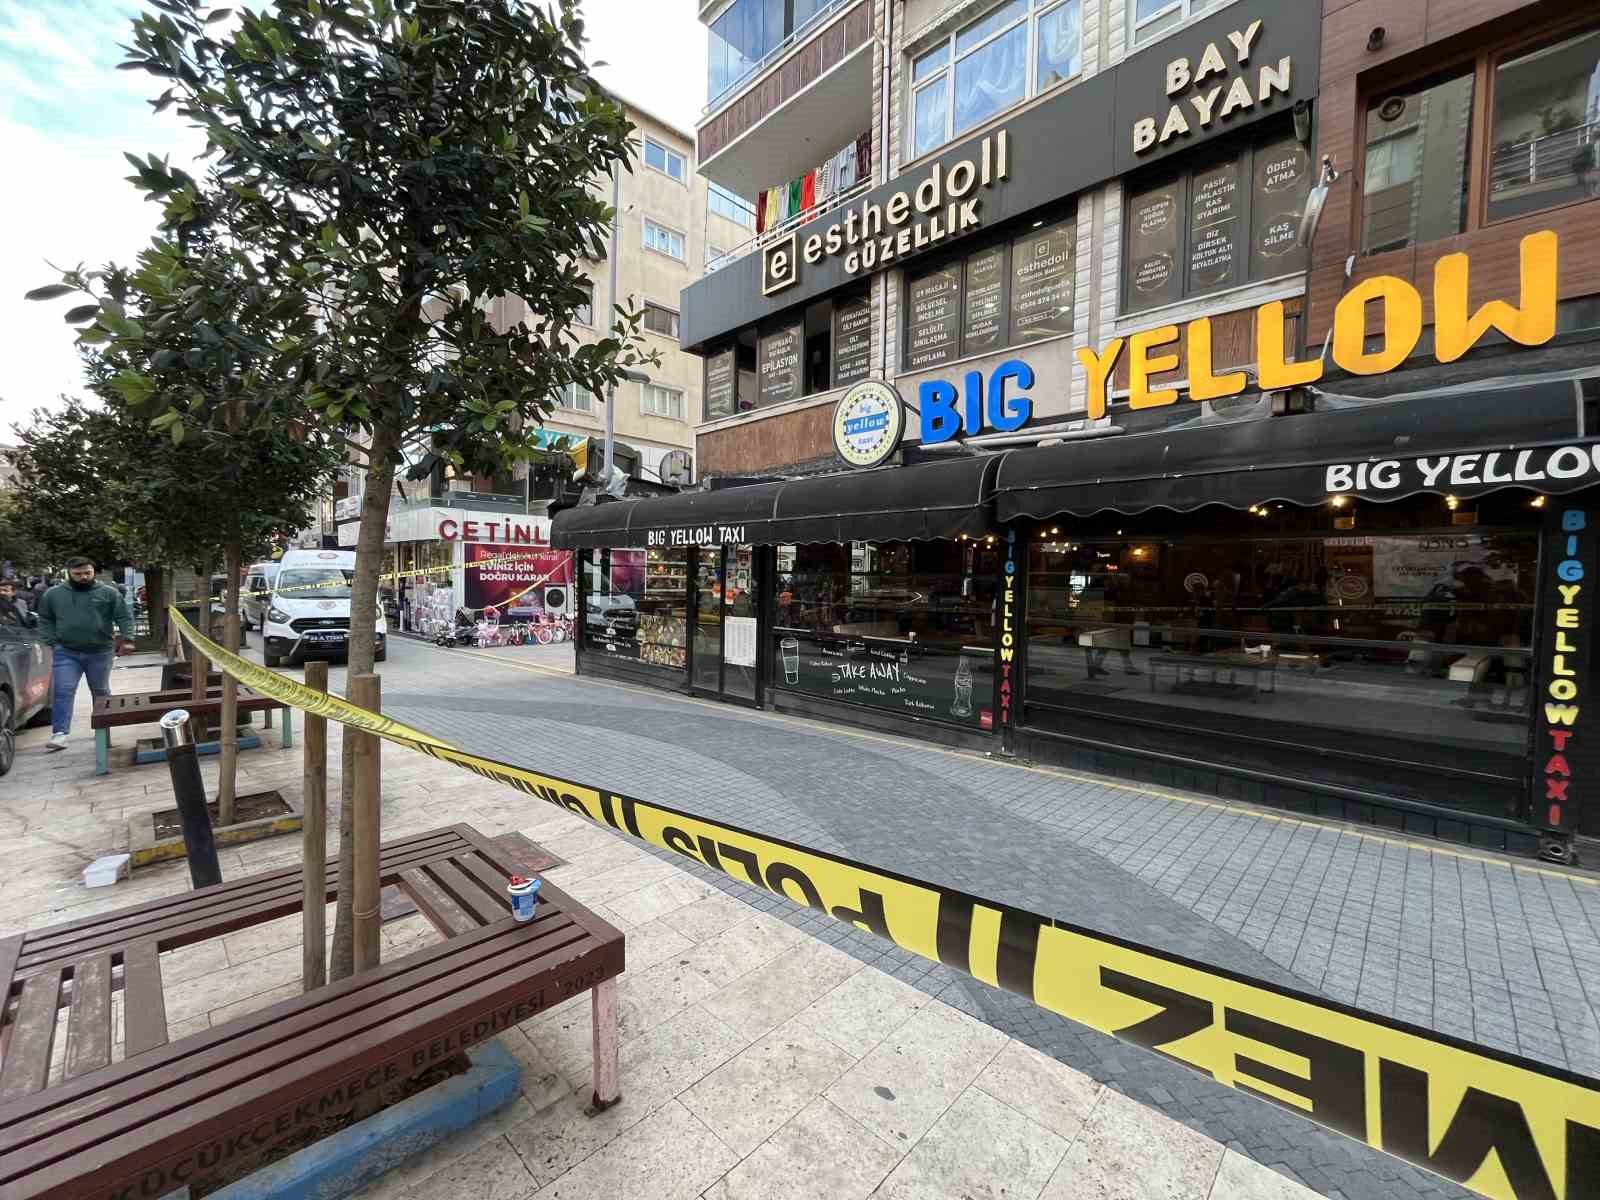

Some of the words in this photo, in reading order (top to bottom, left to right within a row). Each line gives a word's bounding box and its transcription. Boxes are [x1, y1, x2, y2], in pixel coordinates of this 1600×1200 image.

[1166, 19, 1263, 96] BAY
[1133, 56, 1291, 152] BAYAN
[803, 129, 1008, 263] esthedoll
[1266, 170, 1296, 187] ATMA
[1017, 250, 1069, 277] esthedoll
[761, 353, 798, 374] EPİLASYON
[919, 360, 1035, 444] BIG
[1077, 230, 1558, 420] YELLOW
[847, 417, 885, 433] yellow
[1326, 460, 1400, 491] BIG
[1416, 444, 1600, 487] YELLO
[648, 530, 665, 545] BIG
[670, 527, 713, 545] YELLOW
[718, 526, 745, 544] TAXI
[1004, 530, 1015, 573] BIG
[1557, 510, 1587, 582] BIG
[1000, 575, 1014, 662] YELLOW
[837, 662, 866, 680] TAKE
[869, 662, 900, 682] AWAY
[1544, 585, 1581, 726] YELLOW
[1000, 664, 1011, 724] TAXI
[1544, 730, 1573, 826] TAXI
